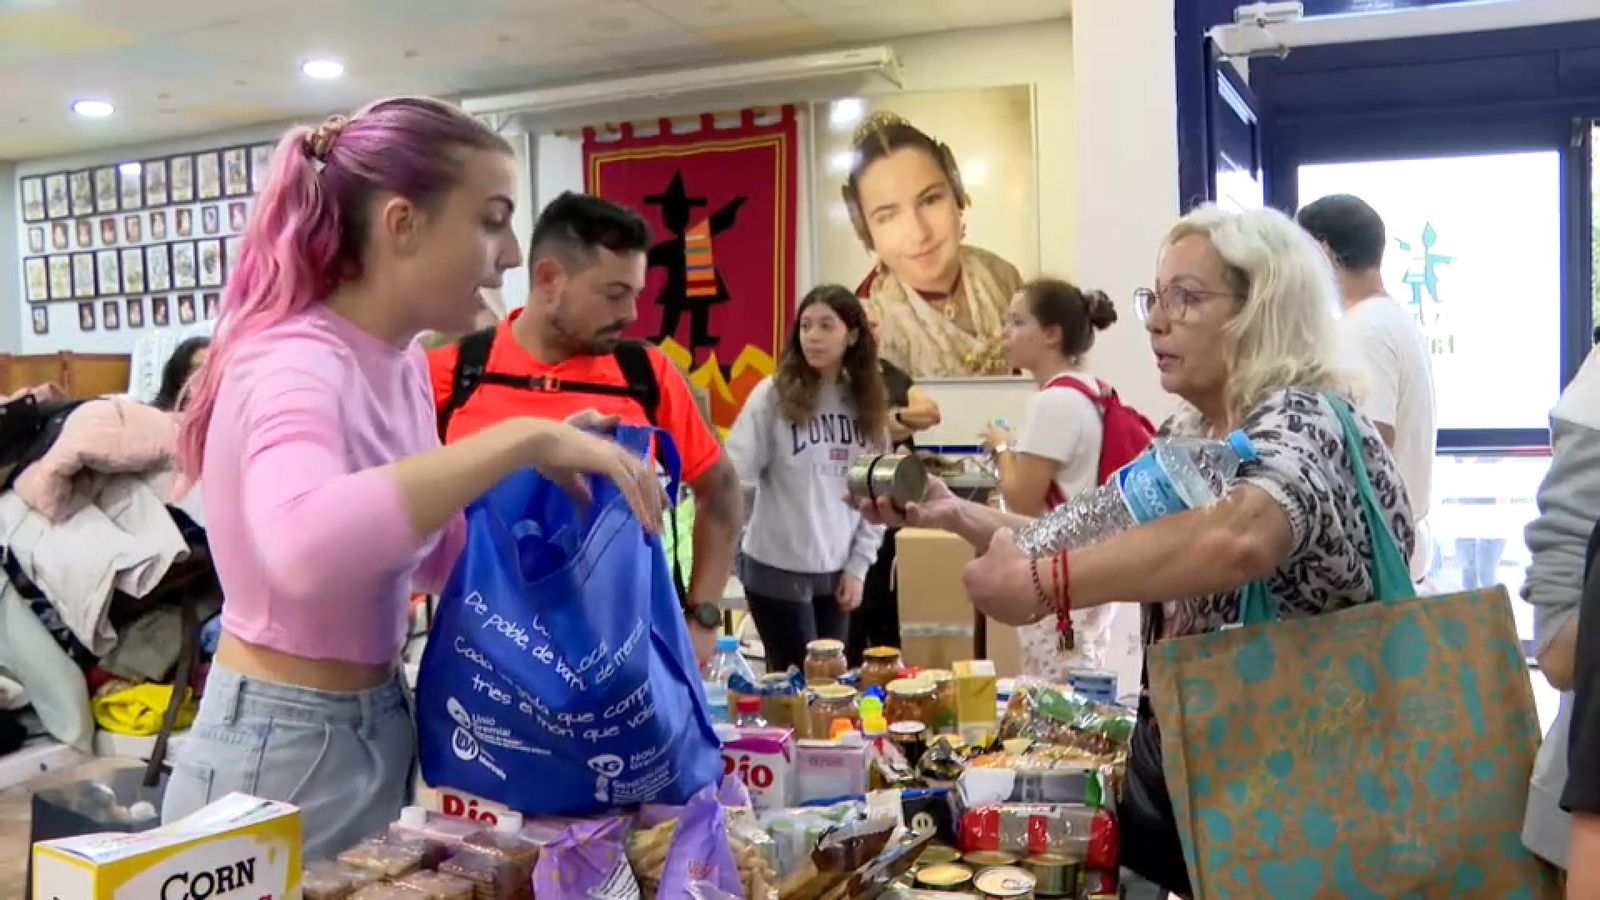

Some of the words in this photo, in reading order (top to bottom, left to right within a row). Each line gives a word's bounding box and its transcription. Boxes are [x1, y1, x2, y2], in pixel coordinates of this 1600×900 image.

[790, 413, 867, 456] LONDO
[464, 590, 488, 616] De
[532, 643, 555, 665] de
[557, 711, 595, 728] que
[582, 724, 621, 743] que
[160, 857, 257, 900] CORN
